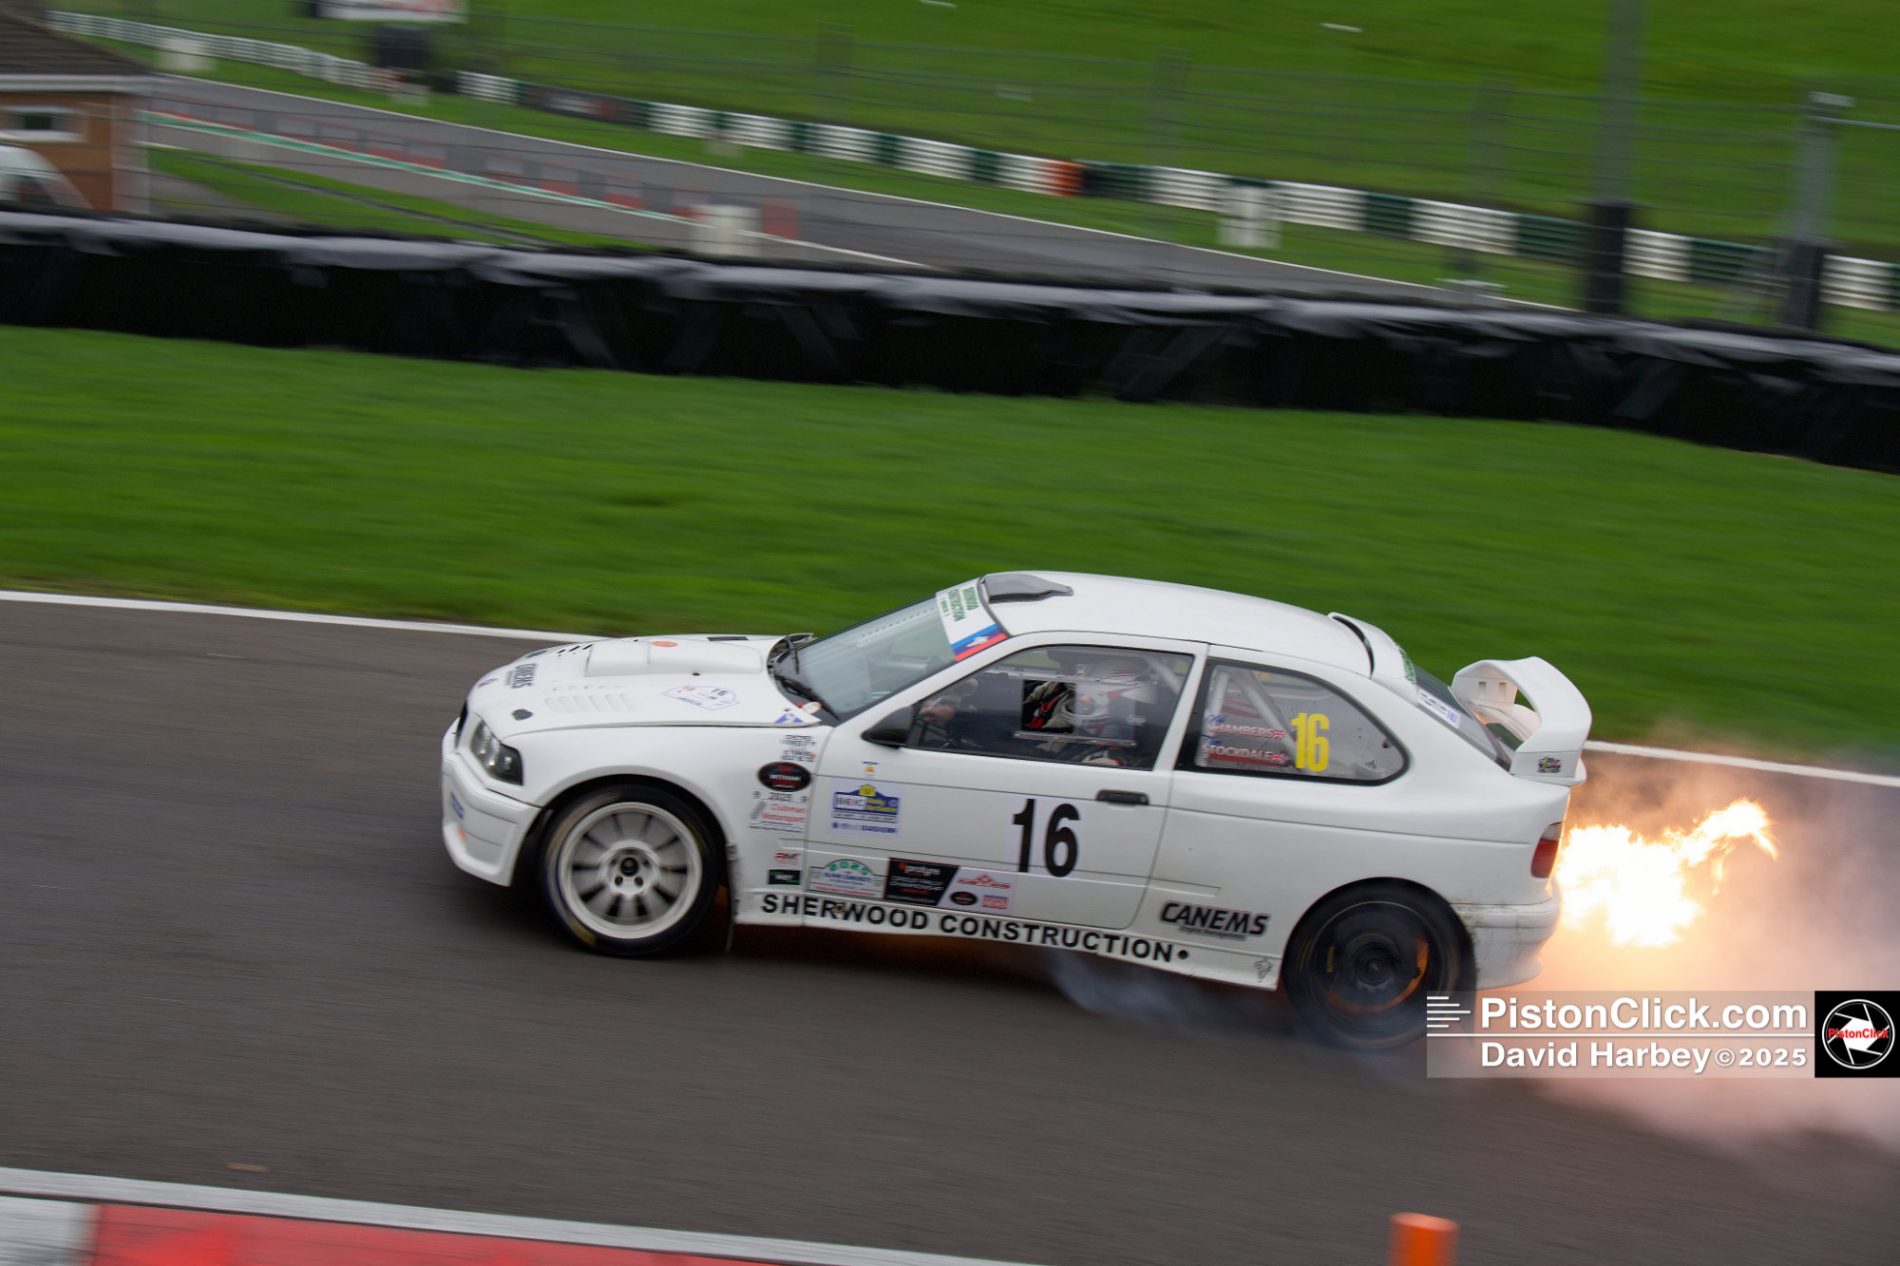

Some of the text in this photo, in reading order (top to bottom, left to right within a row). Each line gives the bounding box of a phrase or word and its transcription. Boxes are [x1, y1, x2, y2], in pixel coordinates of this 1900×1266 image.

[1291, 712, 1329, 772] 16
[1012, 798, 1081, 878] 16
[762, 893, 1173, 963] SHERWOOD CONSTRUCTION
[1160, 901, 1271, 936] CANEMS
